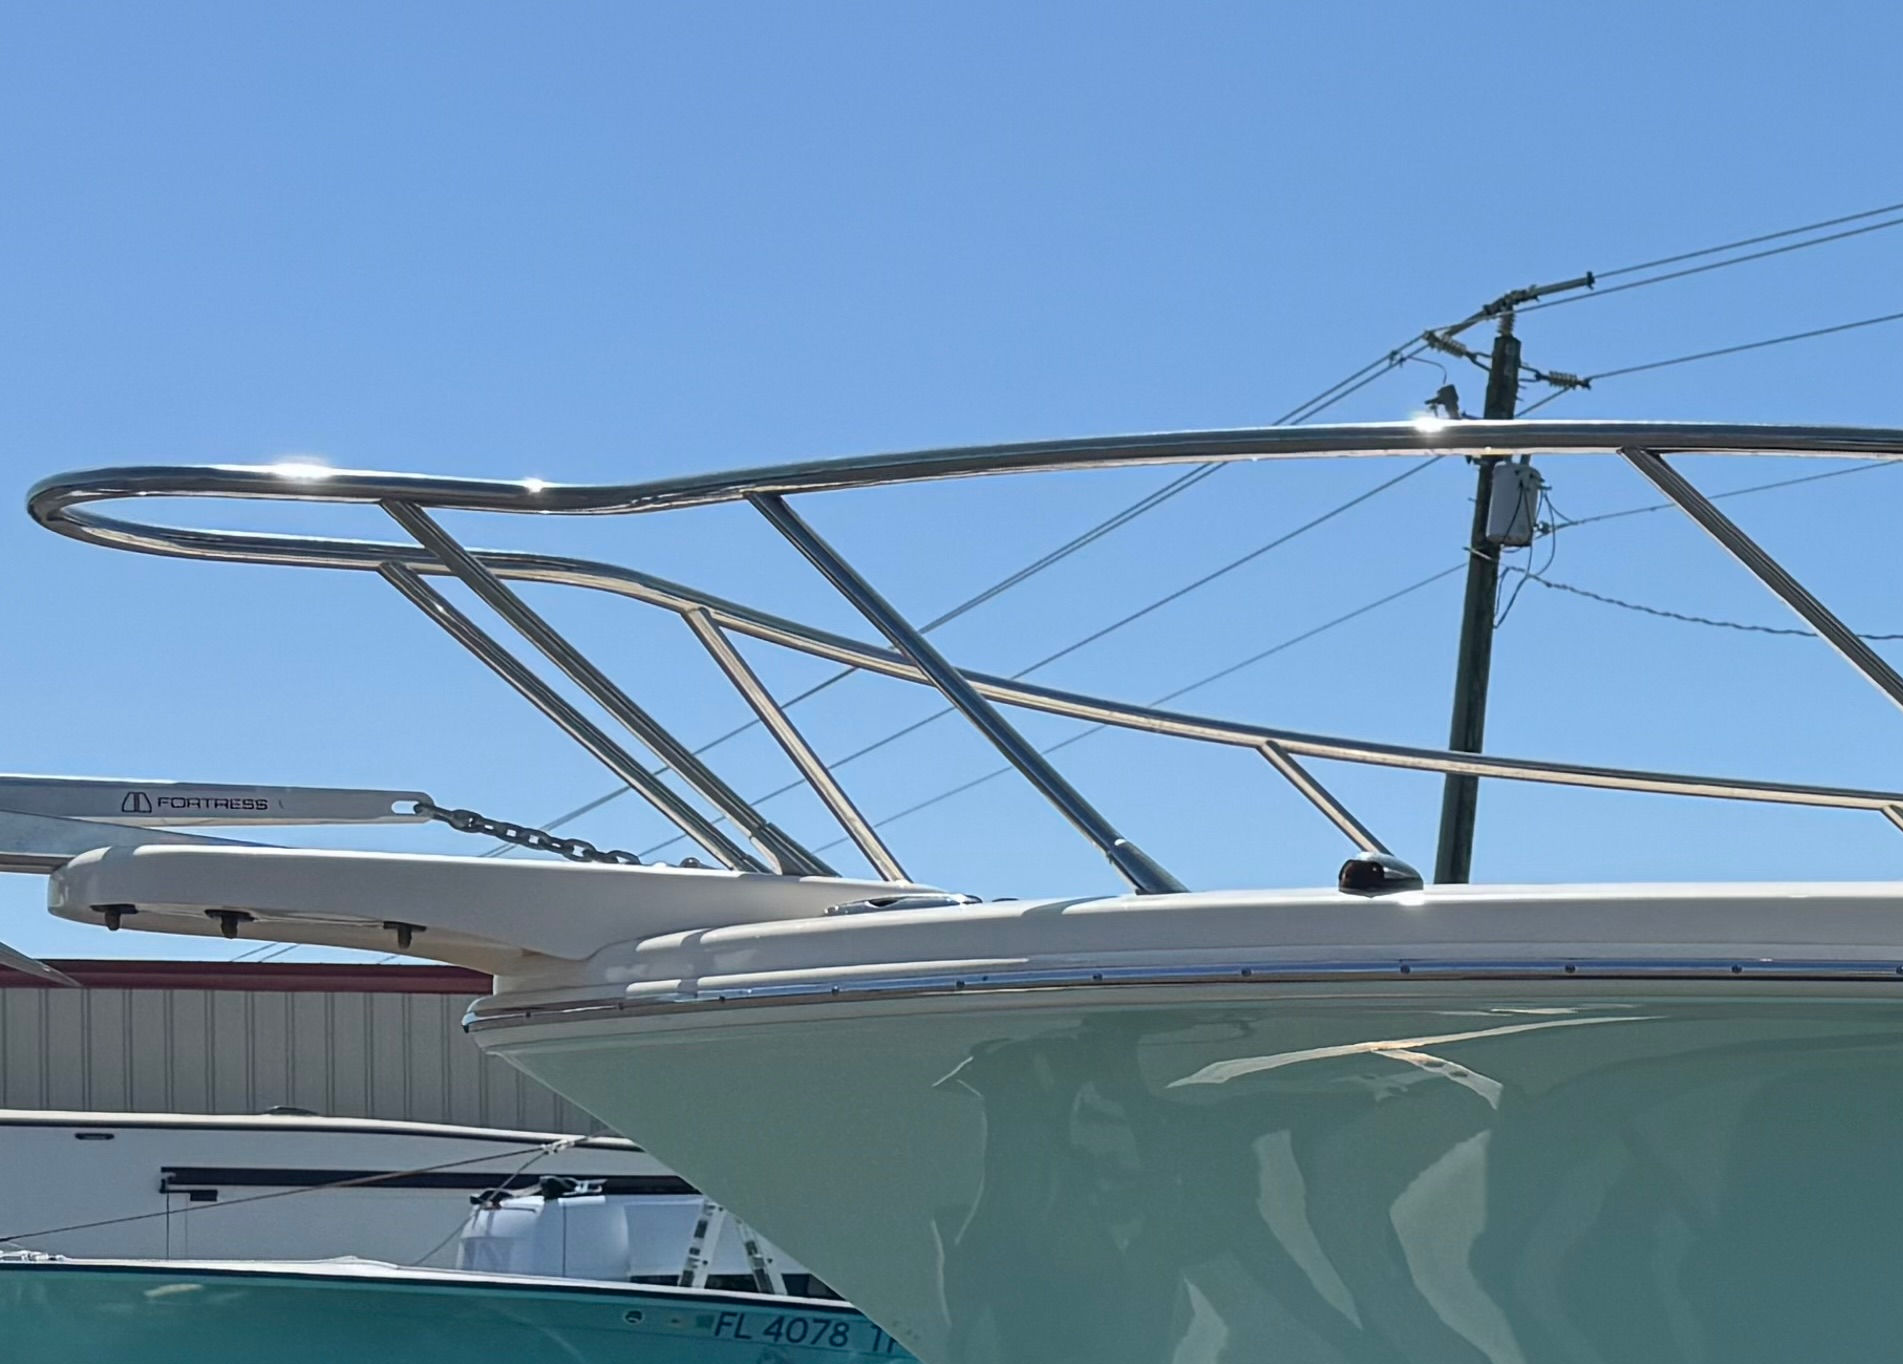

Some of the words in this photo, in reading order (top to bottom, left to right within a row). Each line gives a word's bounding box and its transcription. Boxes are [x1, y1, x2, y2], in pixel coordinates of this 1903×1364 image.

[157, 796, 269, 811] FORTRESS
[714, 1311, 752, 1339] FL
[763, 1315, 850, 1348] 4078
